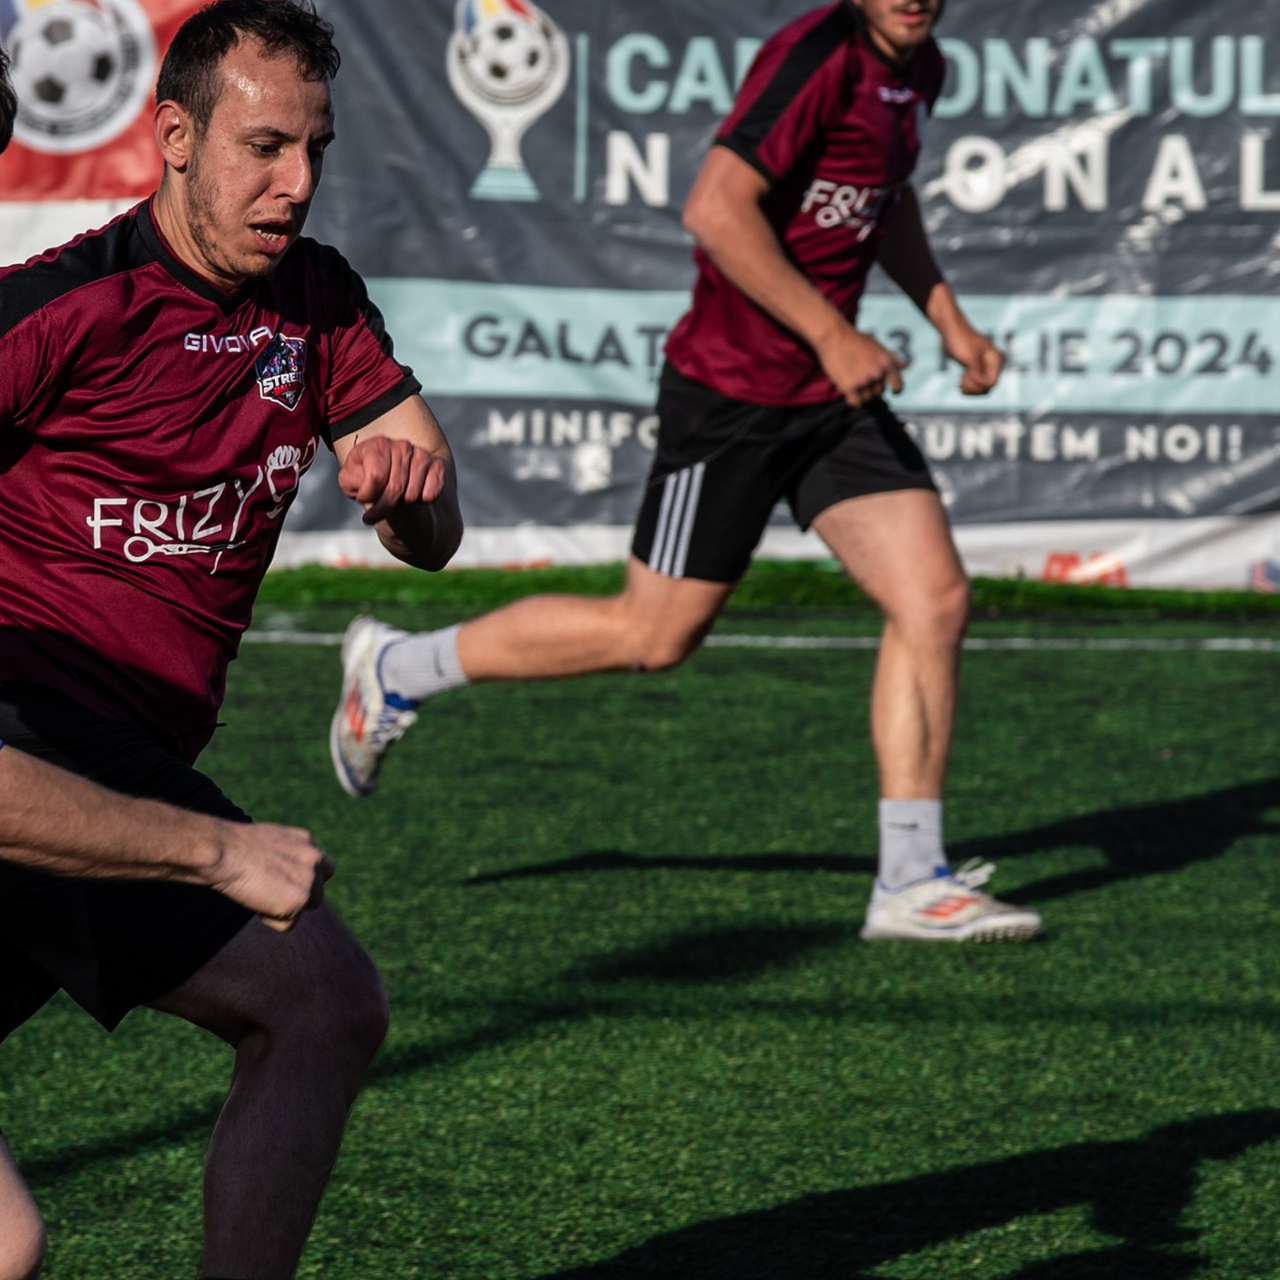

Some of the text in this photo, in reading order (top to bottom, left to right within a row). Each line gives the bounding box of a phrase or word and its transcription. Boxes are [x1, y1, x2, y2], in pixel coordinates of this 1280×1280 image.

[606, 33, 1280, 117] CAONATUL
[605, 131, 1280, 213] NONAL
[183, 325, 274, 353] GIVOVA
[1114, 330, 1272, 378] 2024
[904, 422, 1101, 462] UNTEM
[1124, 423, 1243, 464] NOI!
